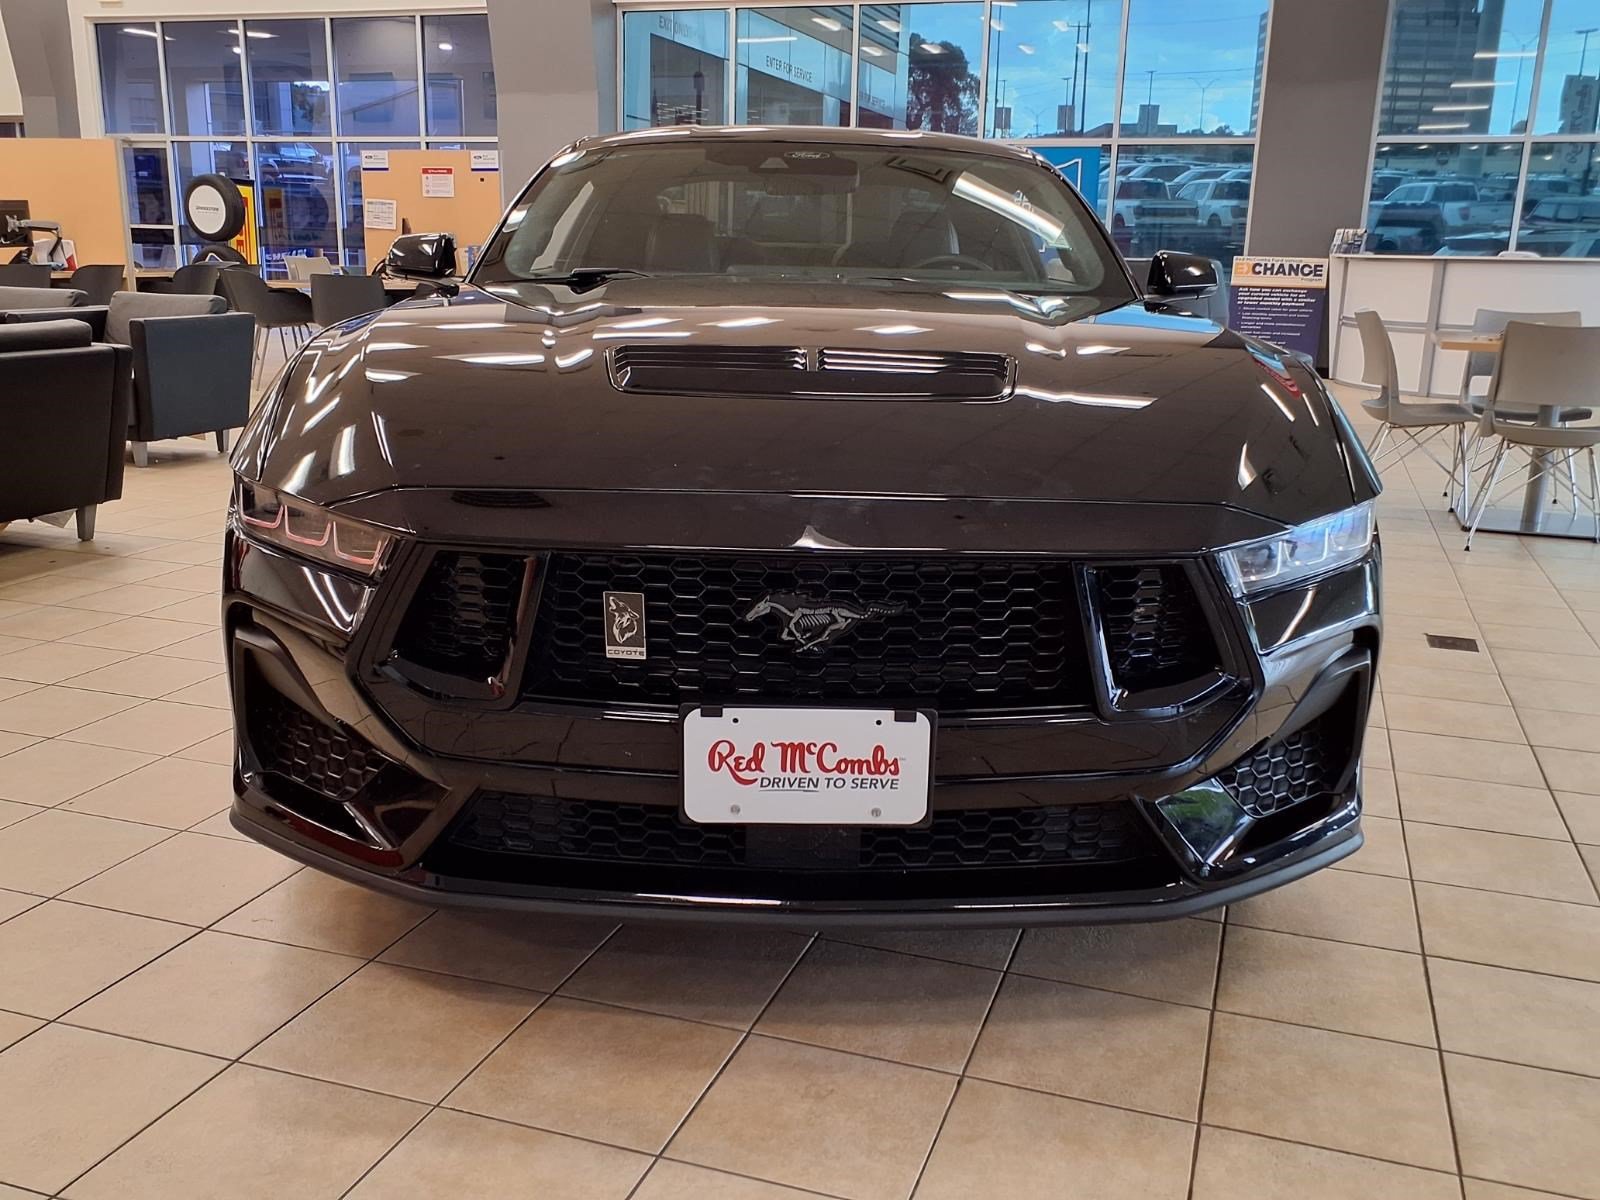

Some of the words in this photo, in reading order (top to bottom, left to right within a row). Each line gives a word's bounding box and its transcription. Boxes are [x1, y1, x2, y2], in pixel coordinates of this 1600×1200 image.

[766, 55, 782, 71] ENTER
[783, 62, 793, 75] FOR
[793, 66, 813, 83] SERVICE
[608, 649, 645, 657] COYOTE
[707, 739, 766, 785] Red
[770, 741, 900, 776] McCombs
[759, 777, 819, 789] DRIVEN
[824, 777, 846, 789] TO
[850, 778, 900, 790] SERVE
